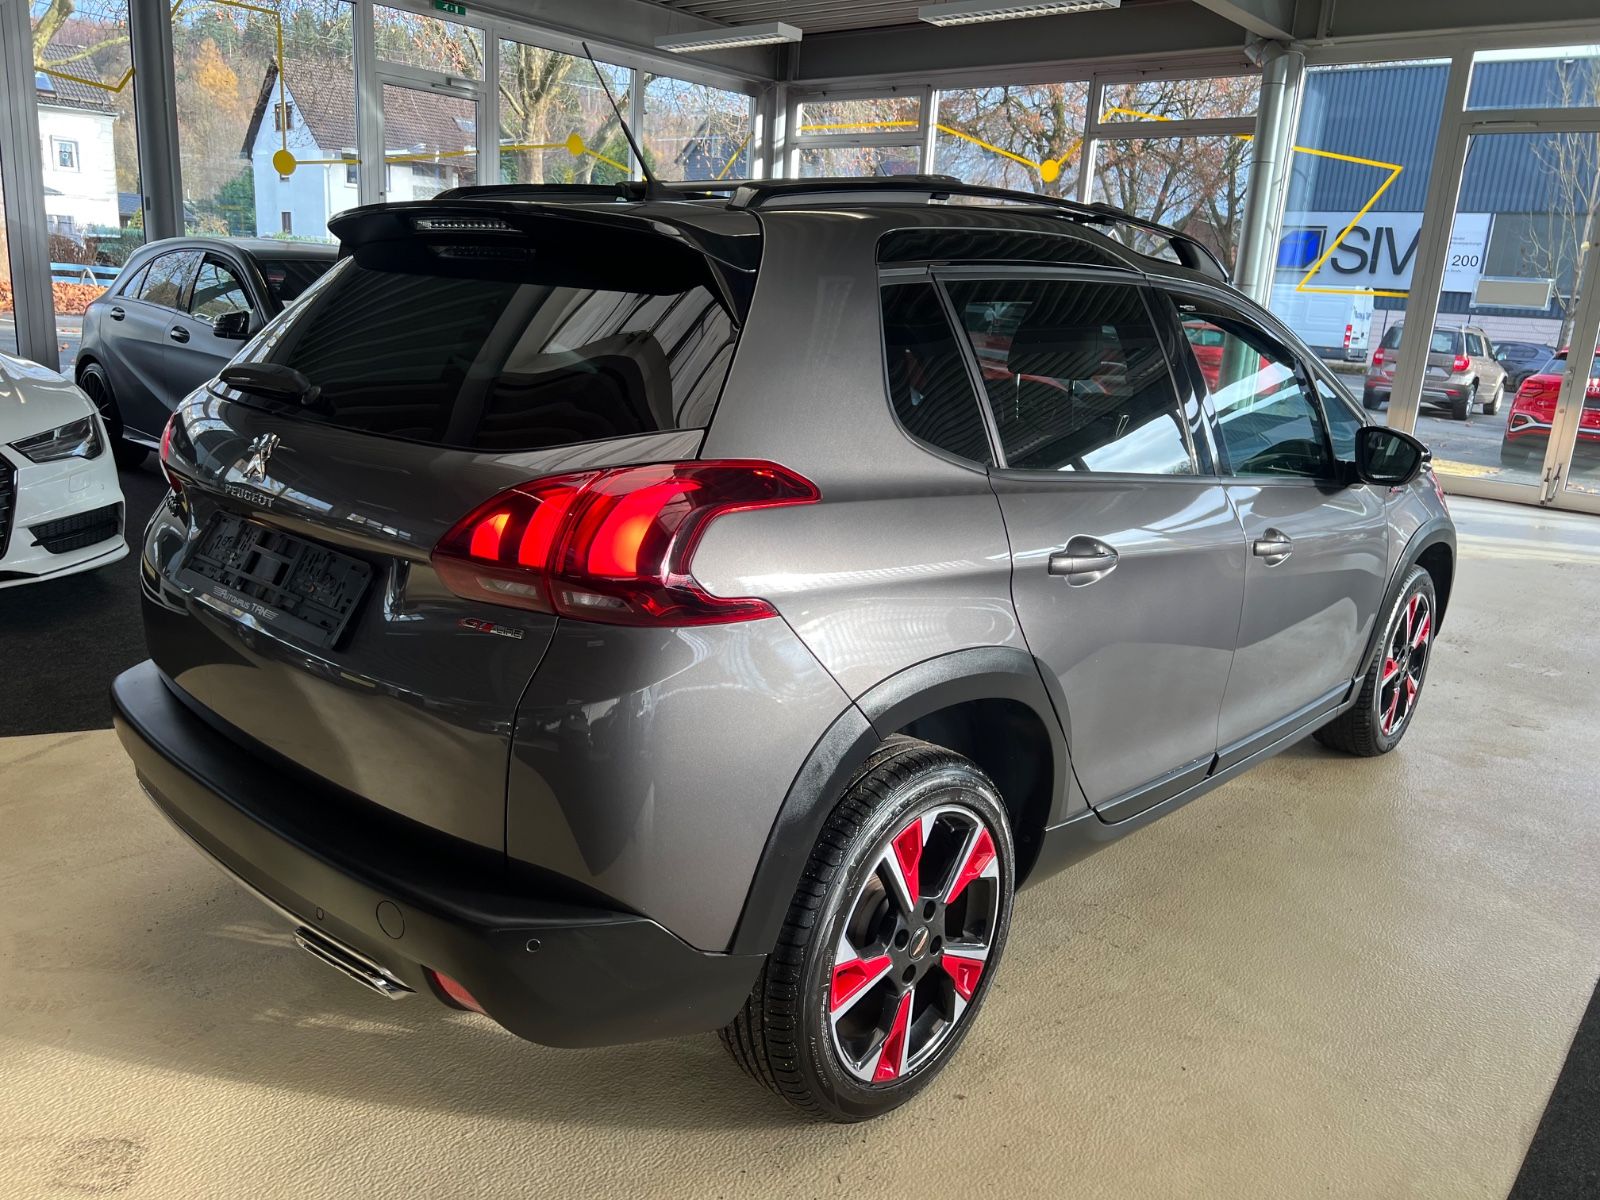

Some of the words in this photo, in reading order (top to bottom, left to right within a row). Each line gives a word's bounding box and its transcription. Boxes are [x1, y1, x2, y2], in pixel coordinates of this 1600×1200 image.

[1451, 254, 1479, 267] 200
[224, 483, 275, 508] PEUGEOT
[219, 588, 251, 610] AUTOHAUS
